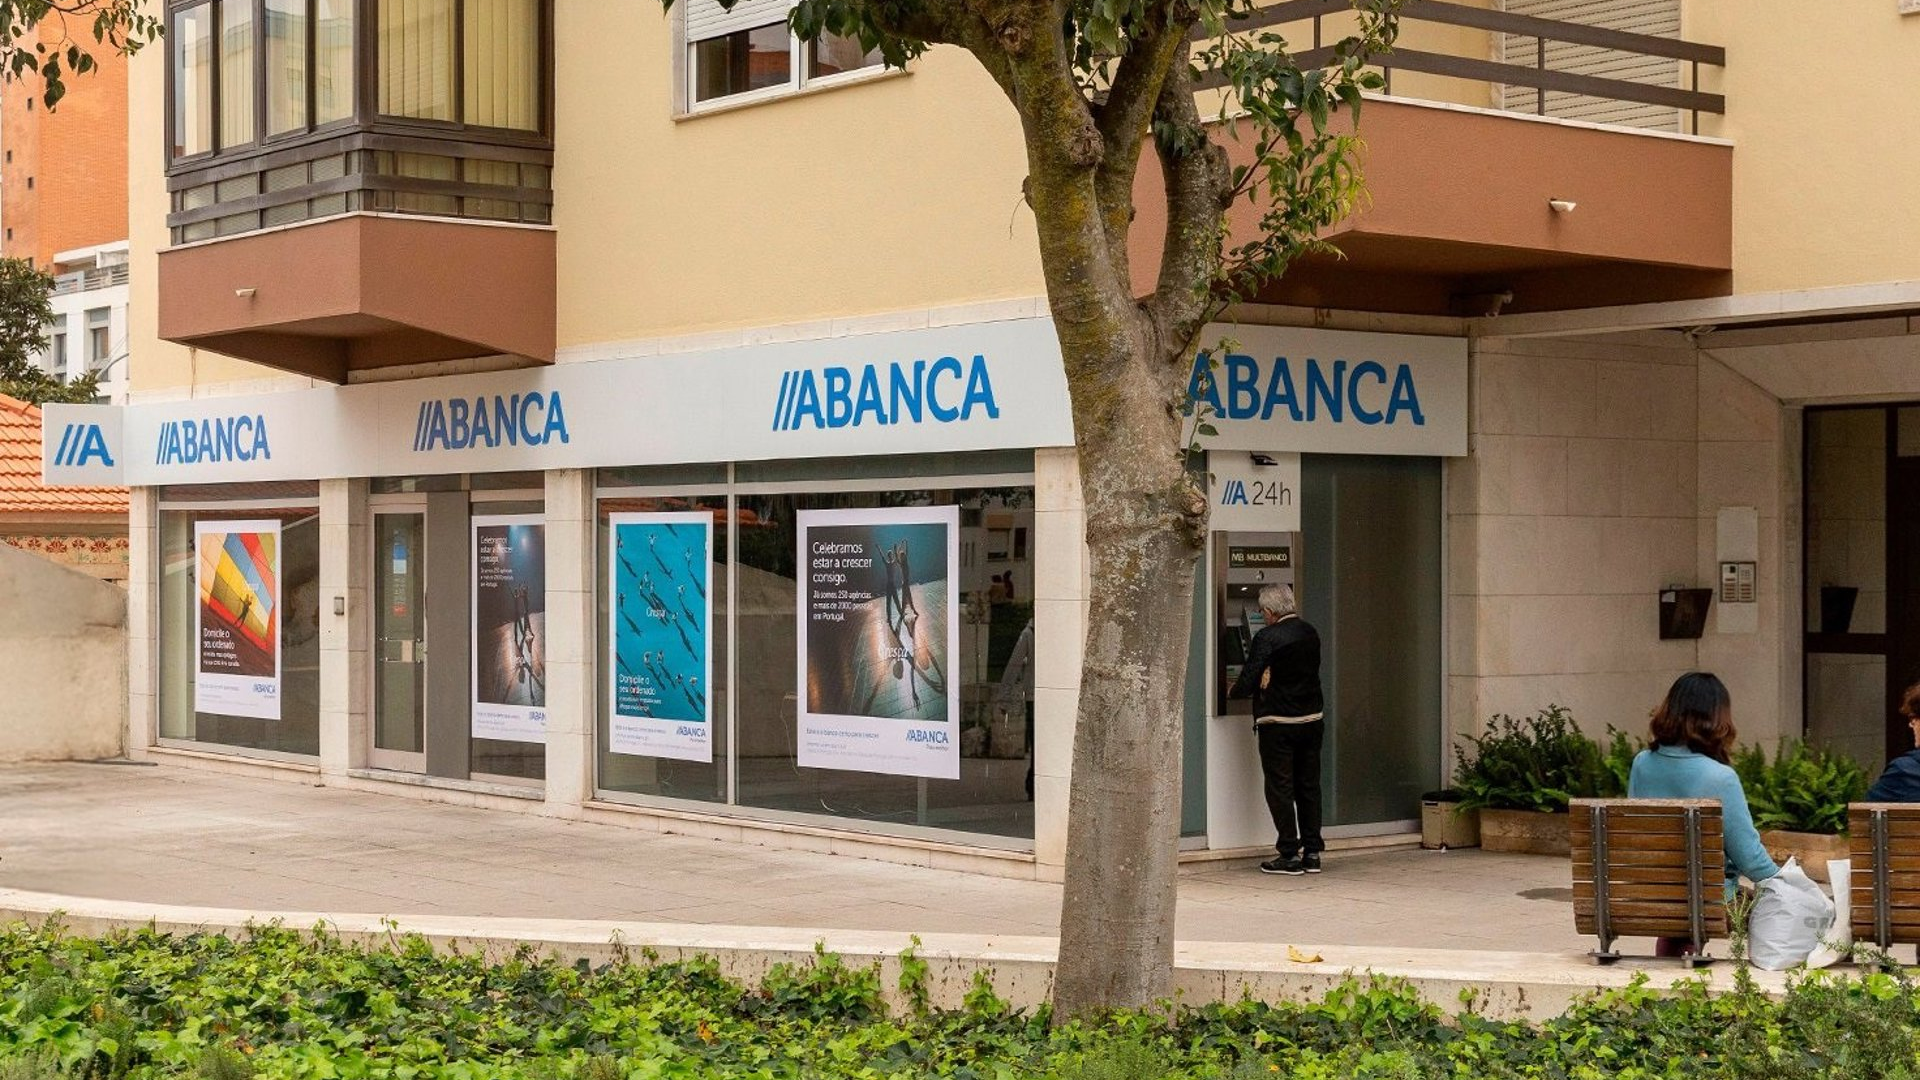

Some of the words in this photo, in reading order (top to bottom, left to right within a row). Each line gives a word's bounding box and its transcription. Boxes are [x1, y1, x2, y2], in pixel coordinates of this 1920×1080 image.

[1252, 481, 1291, 506] 24h
[812, 541, 863, 555] Celebramos
[812, 558, 834, 569] estar
[834, 560, 840, 568] a
[841, 558, 873, 568] crescer
[1246, 553, 1288, 562] MULTIBANCO
[812, 571, 847, 586] consigo.
